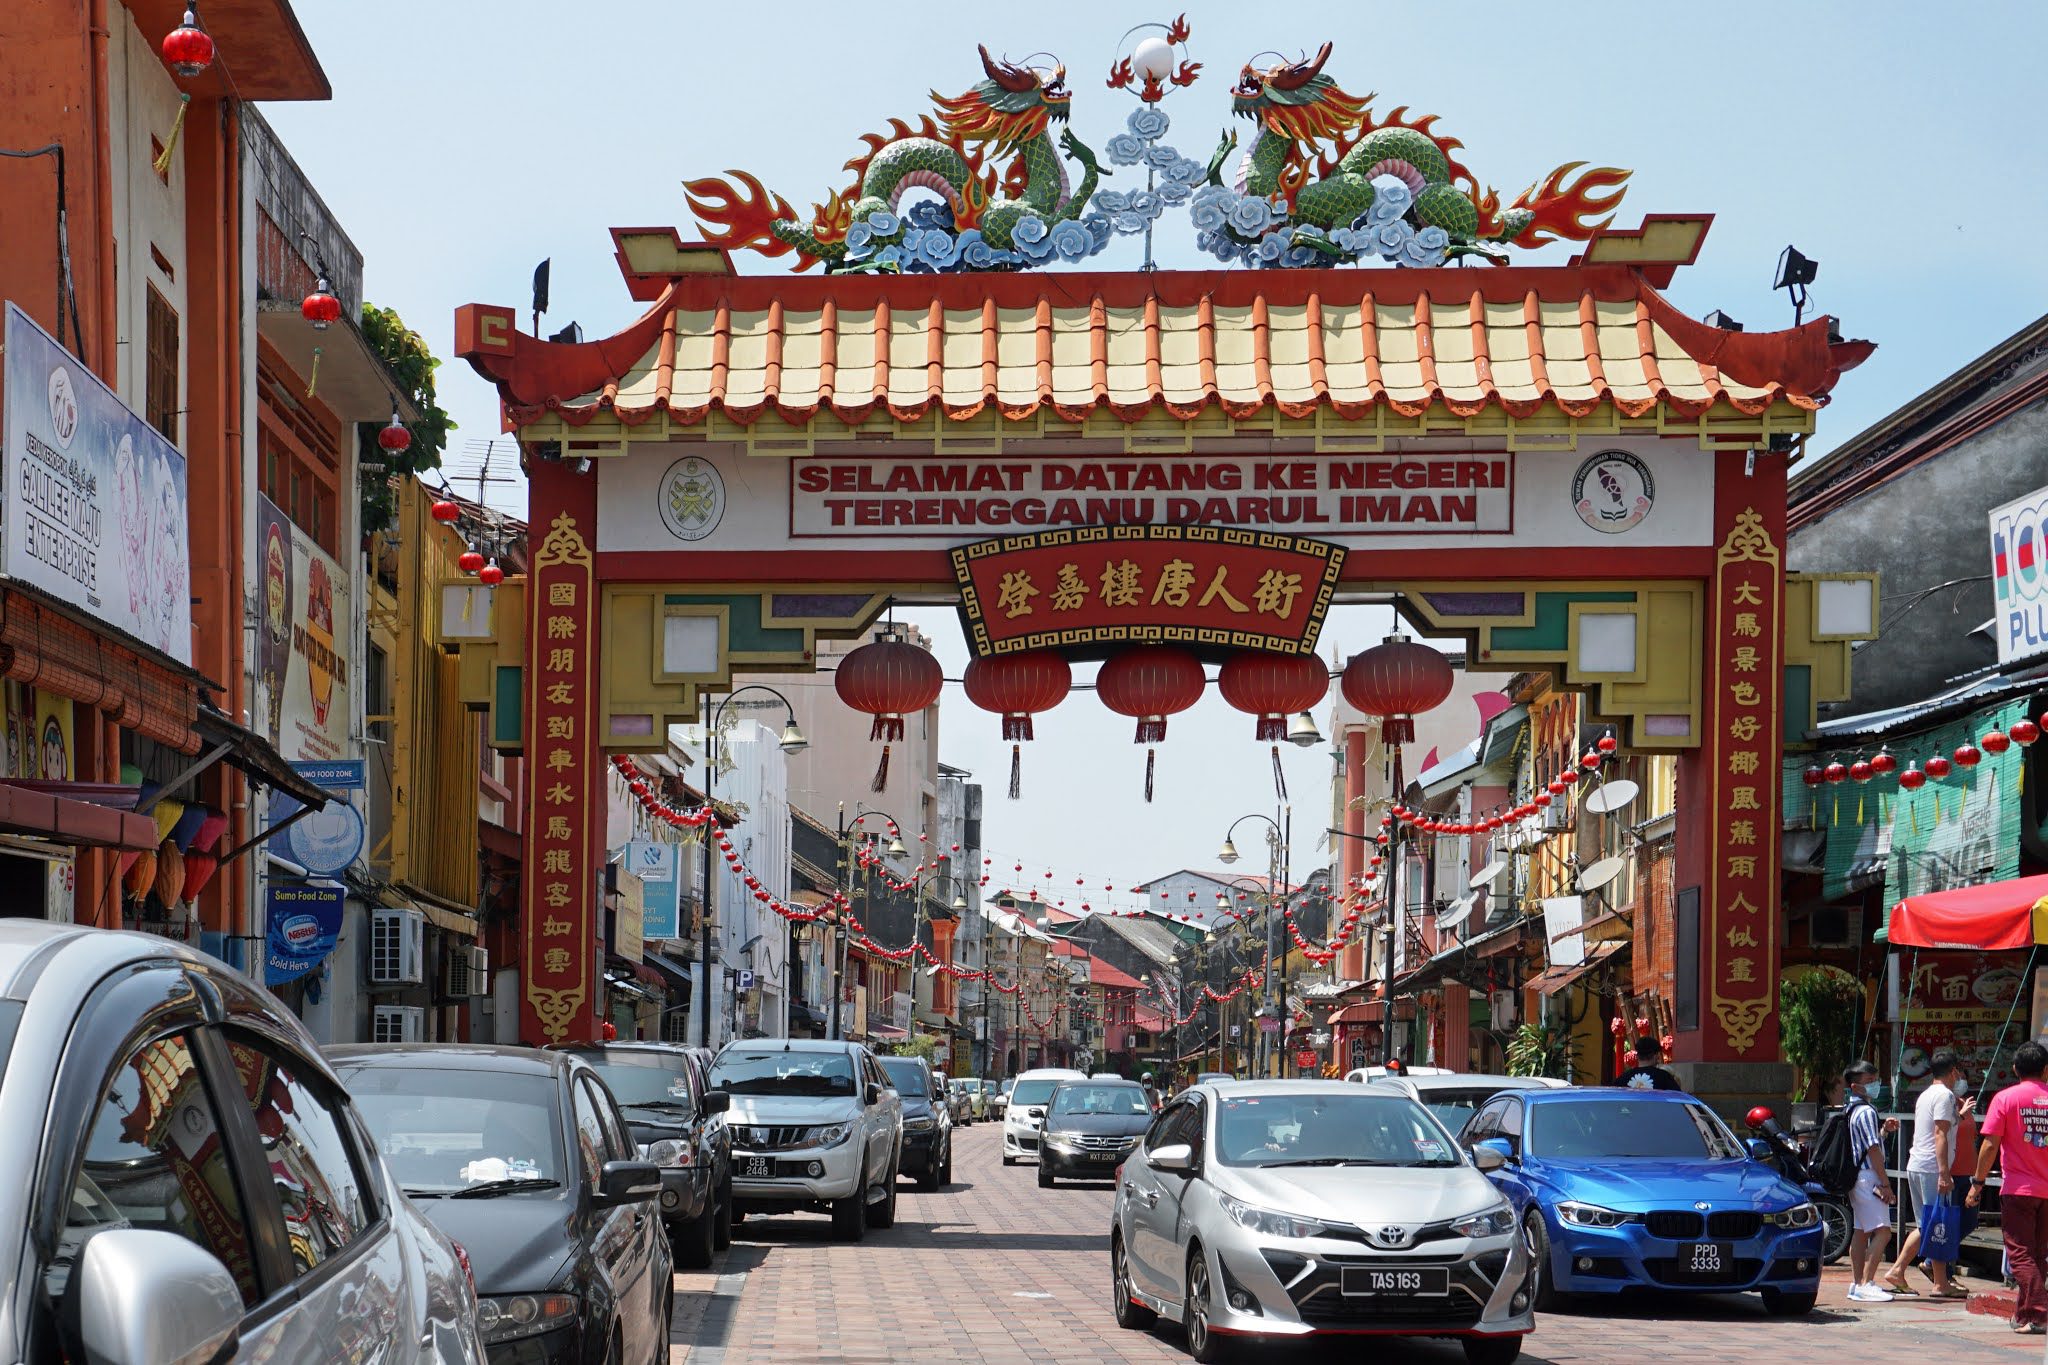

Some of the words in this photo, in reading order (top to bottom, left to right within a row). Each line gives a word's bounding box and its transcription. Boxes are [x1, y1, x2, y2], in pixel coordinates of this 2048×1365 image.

[798, 464, 1032, 493] SELAMAT
[1041, 463, 1242, 491] DATANG
[1254, 463, 1317, 490] KE
[1329, 461, 1506, 489] NEGERI
[19, 458, 69, 525] GALILEE
[71, 491, 101, 548] MAJU
[824, 498, 1154, 526] TERENGGANU
[1165, 496, 1329, 525] DARUL
[1339, 495, 1477, 524] IMAN
[24, 511, 96, 591] ENTERPRISE
[997, 558, 1303, 620] 登嘉樓唐人街
[542, 583, 578, 974] 國際朋友到車水馬龍客如雲
[1725, 580, 1763, 983] 大馬景色好椰風蕉雨人似畫
[275, 890, 296, 900] Sumo
[298, 890, 316, 901] Food
[318, 891, 337, 901] Zone
[269, 955, 288, 970] Sold
[289, 961, 309, 971] Here
[741, 971, 752, 985] P
[1232, 1026, 1240, 1036] P
[749, 1157, 765, 1167] CEB
[746, 1166, 769, 1176] 2446
[1695, 1244, 1718, 1257] PPD
[1690, 1257, 1721, 1270] 3333
[1370, 1272, 1396, 1289] TAS
[1397, 1272, 1421, 1289] 163
